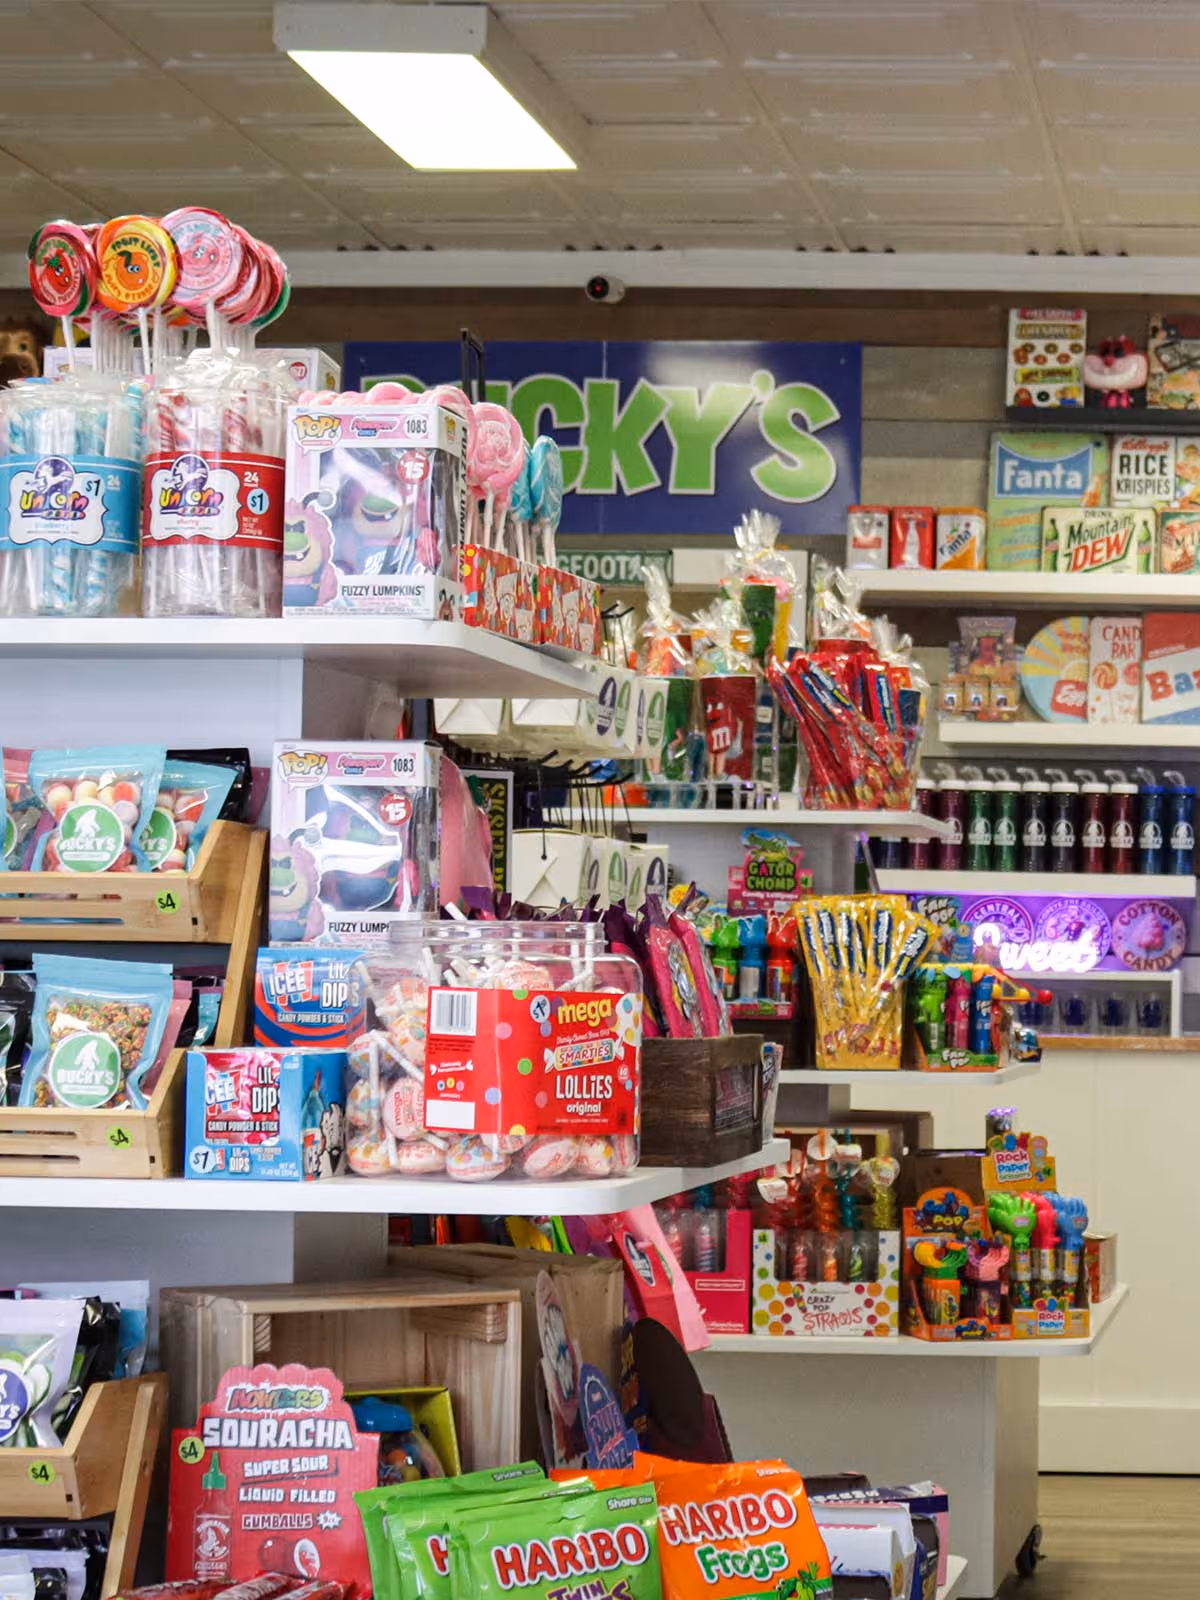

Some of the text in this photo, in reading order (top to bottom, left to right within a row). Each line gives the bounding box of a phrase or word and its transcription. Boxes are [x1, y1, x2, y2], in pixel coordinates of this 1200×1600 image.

[293, 414, 341, 438] POP!
[405, 418, 428, 435] 1083
[361, 369, 841, 504] CKY'S
[1118, 454, 1168, 476] RICE
[244, 472, 259, 483] 24
[1003, 459, 1082, 491] Fanta
[85, 478, 101, 498] $1
[1116, 479, 1171, 496] KRISPIES
[250, 493, 265, 512] $1
[1067, 515, 1135, 549] Mountain
[939, 529, 972, 556] Fanta
[1070, 529, 1130, 572] DEW
[552, 555, 632, 583] GFOOT
[341, 585, 422, 597] FUZZY LUMPKINS
[1103, 625, 1142, 641] CAND
[1111, 642, 1135, 659] BAR
[279, 752, 328, 776] POP!
[392, 757, 415, 773] 1083
[748, 861, 794, 876] GATOR
[747, 876, 796, 891] CHOMP
[158, 893, 176, 909] $4
[917, 898, 948, 913] FAN
[974, 902, 1021, 921] CENTRAL
[1118, 902, 1180, 926] COTTON
[328, 922, 390, 933] FUZZY LUMP
[1123, 950, 1176, 971] CANDY
[269, 969, 307, 996] ICEE
[322, 982, 361, 1008] DIPS
[557, 998, 612, 1027] mega
[559, 1044, 610, 1064] SMARTIES
[205, 1078, 236, 1105] CEE
[252, 1086, 280, 1113] DIP
[566, 1101, 602, 1115] original
[208, 1121, 227, 1131] CANDY
[228, 1121, 254, 1131] POWDER
[261, 1120, 278, 1131] STICK
[110, 1129, 129, 1147] $4
[192, 1151, 209, 1170] $1
[229, 1157, 250, 1173] DIPS
[995, 1151, 1028, 1163] Rock
[933, 1215, 963, 1226] POP
[807, 1295, 835, 1304] CRAZY
[813, 1304, 829, 1312] POP
[202, 1417, 356, 1450] SOURACHA
[180, 1441, 198, 1460] $4
[32, 1463, 50, 1480] $4
[243, 1455, 329, 1478] SUPER SOUR
[493, 1470, 522, 1481] Share
[608, 1497, 637, 1510] Share
[242, 1513, 314, 1529] GUMBALLS
[657, 1487, 798, 1546] HARIBO
[492, 1523, 650, 1590] HARIBO
[696, 1541, 790, 1585] Frogs
